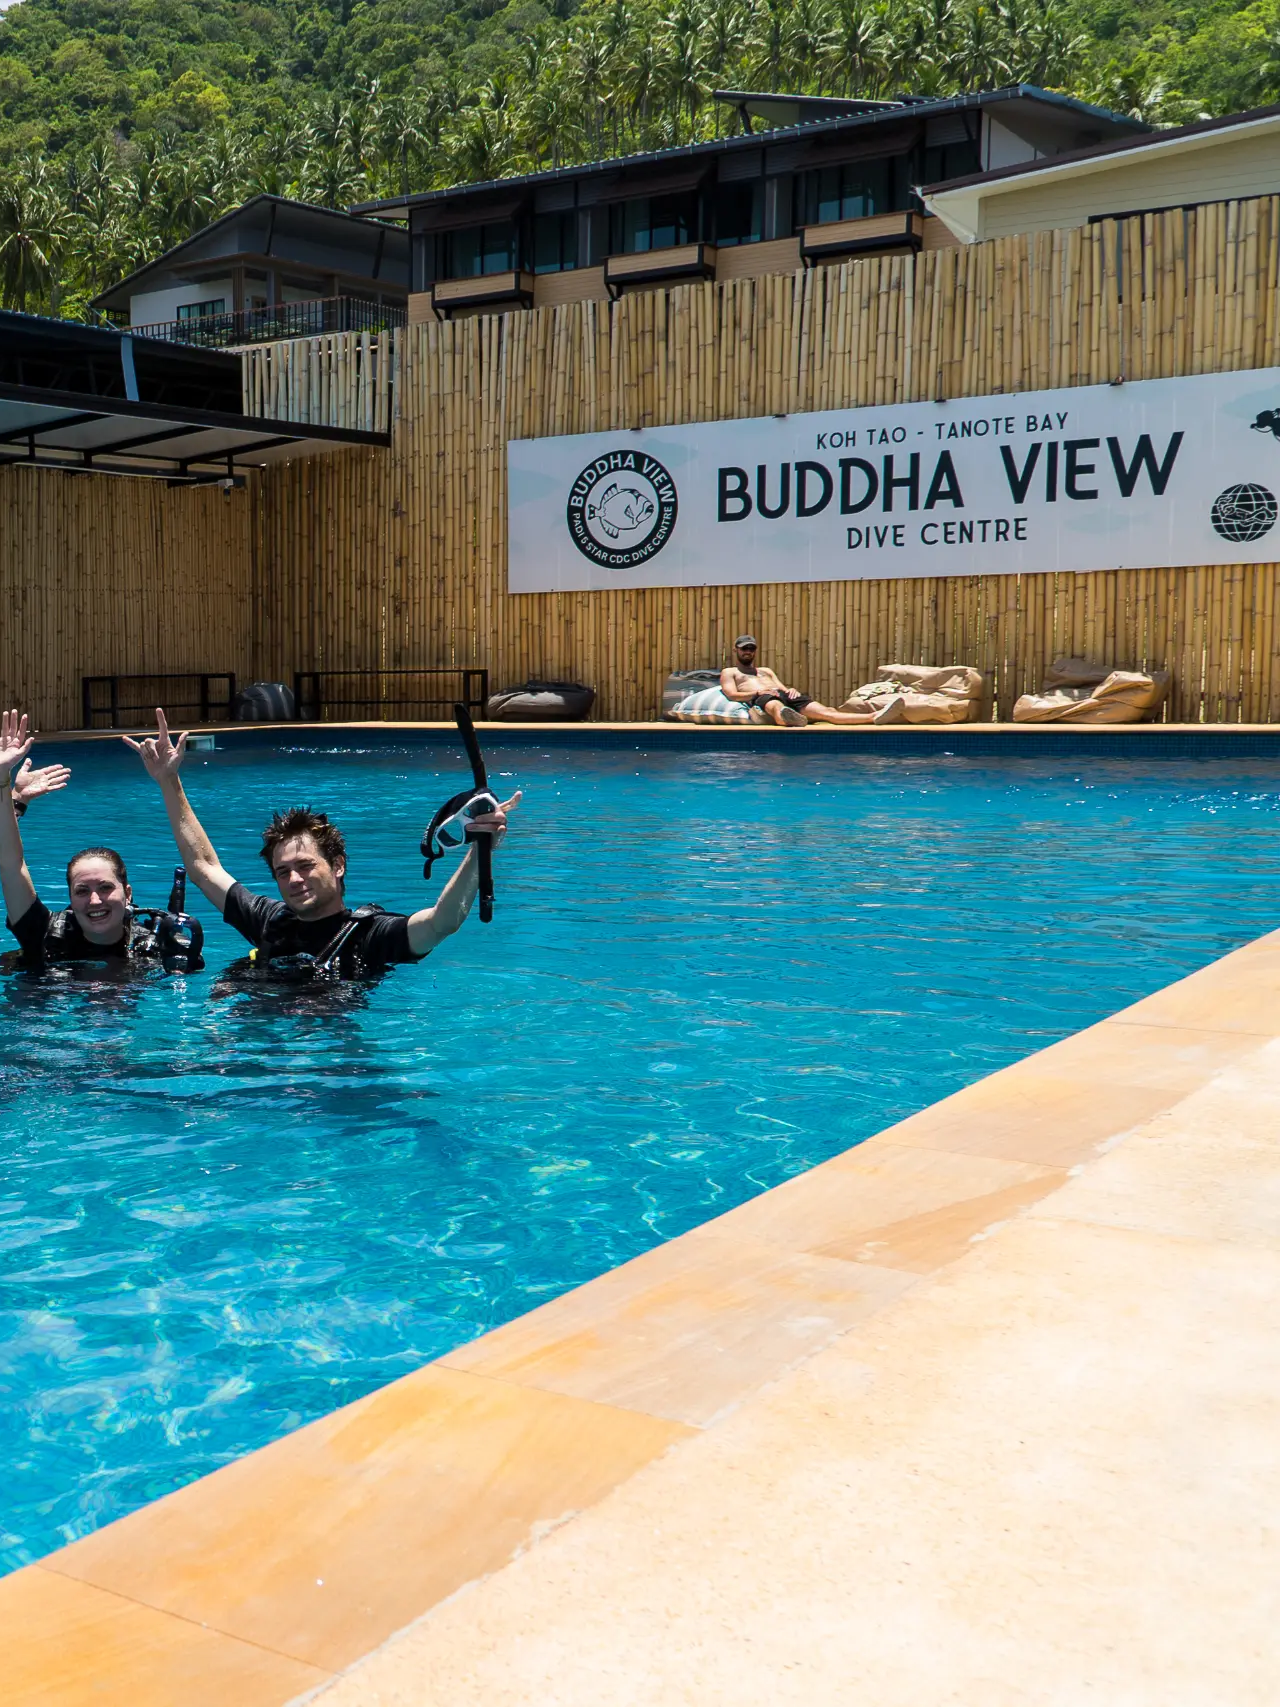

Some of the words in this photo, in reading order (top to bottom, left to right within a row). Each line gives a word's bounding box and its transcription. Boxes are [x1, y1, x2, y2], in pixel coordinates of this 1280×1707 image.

[816, 430, 857, 450] KOH
[867, 426, 907, 446] TAO
[934, 416, 1015, 441] TANOTE
[1026, 411, 1069, 433] BAY
[570, 453, 636, 508] BUDDHA
[642, 457, 675, 503] VIEW
[717, 449, 965, 523] BUDDHA
[999, 430, 1186, 505] VIEW
[572, 512, 584, 538] PADI
[585, 542, 609, 561] STAR
[609, 553, 631, 564] CDC
[631, 542, 655, 563] DIVE
[651, 505, 673, 546] CENTRE
[847, 523, 906, 550] DIVE
[920, 517, 1029, 546] CENTRE
